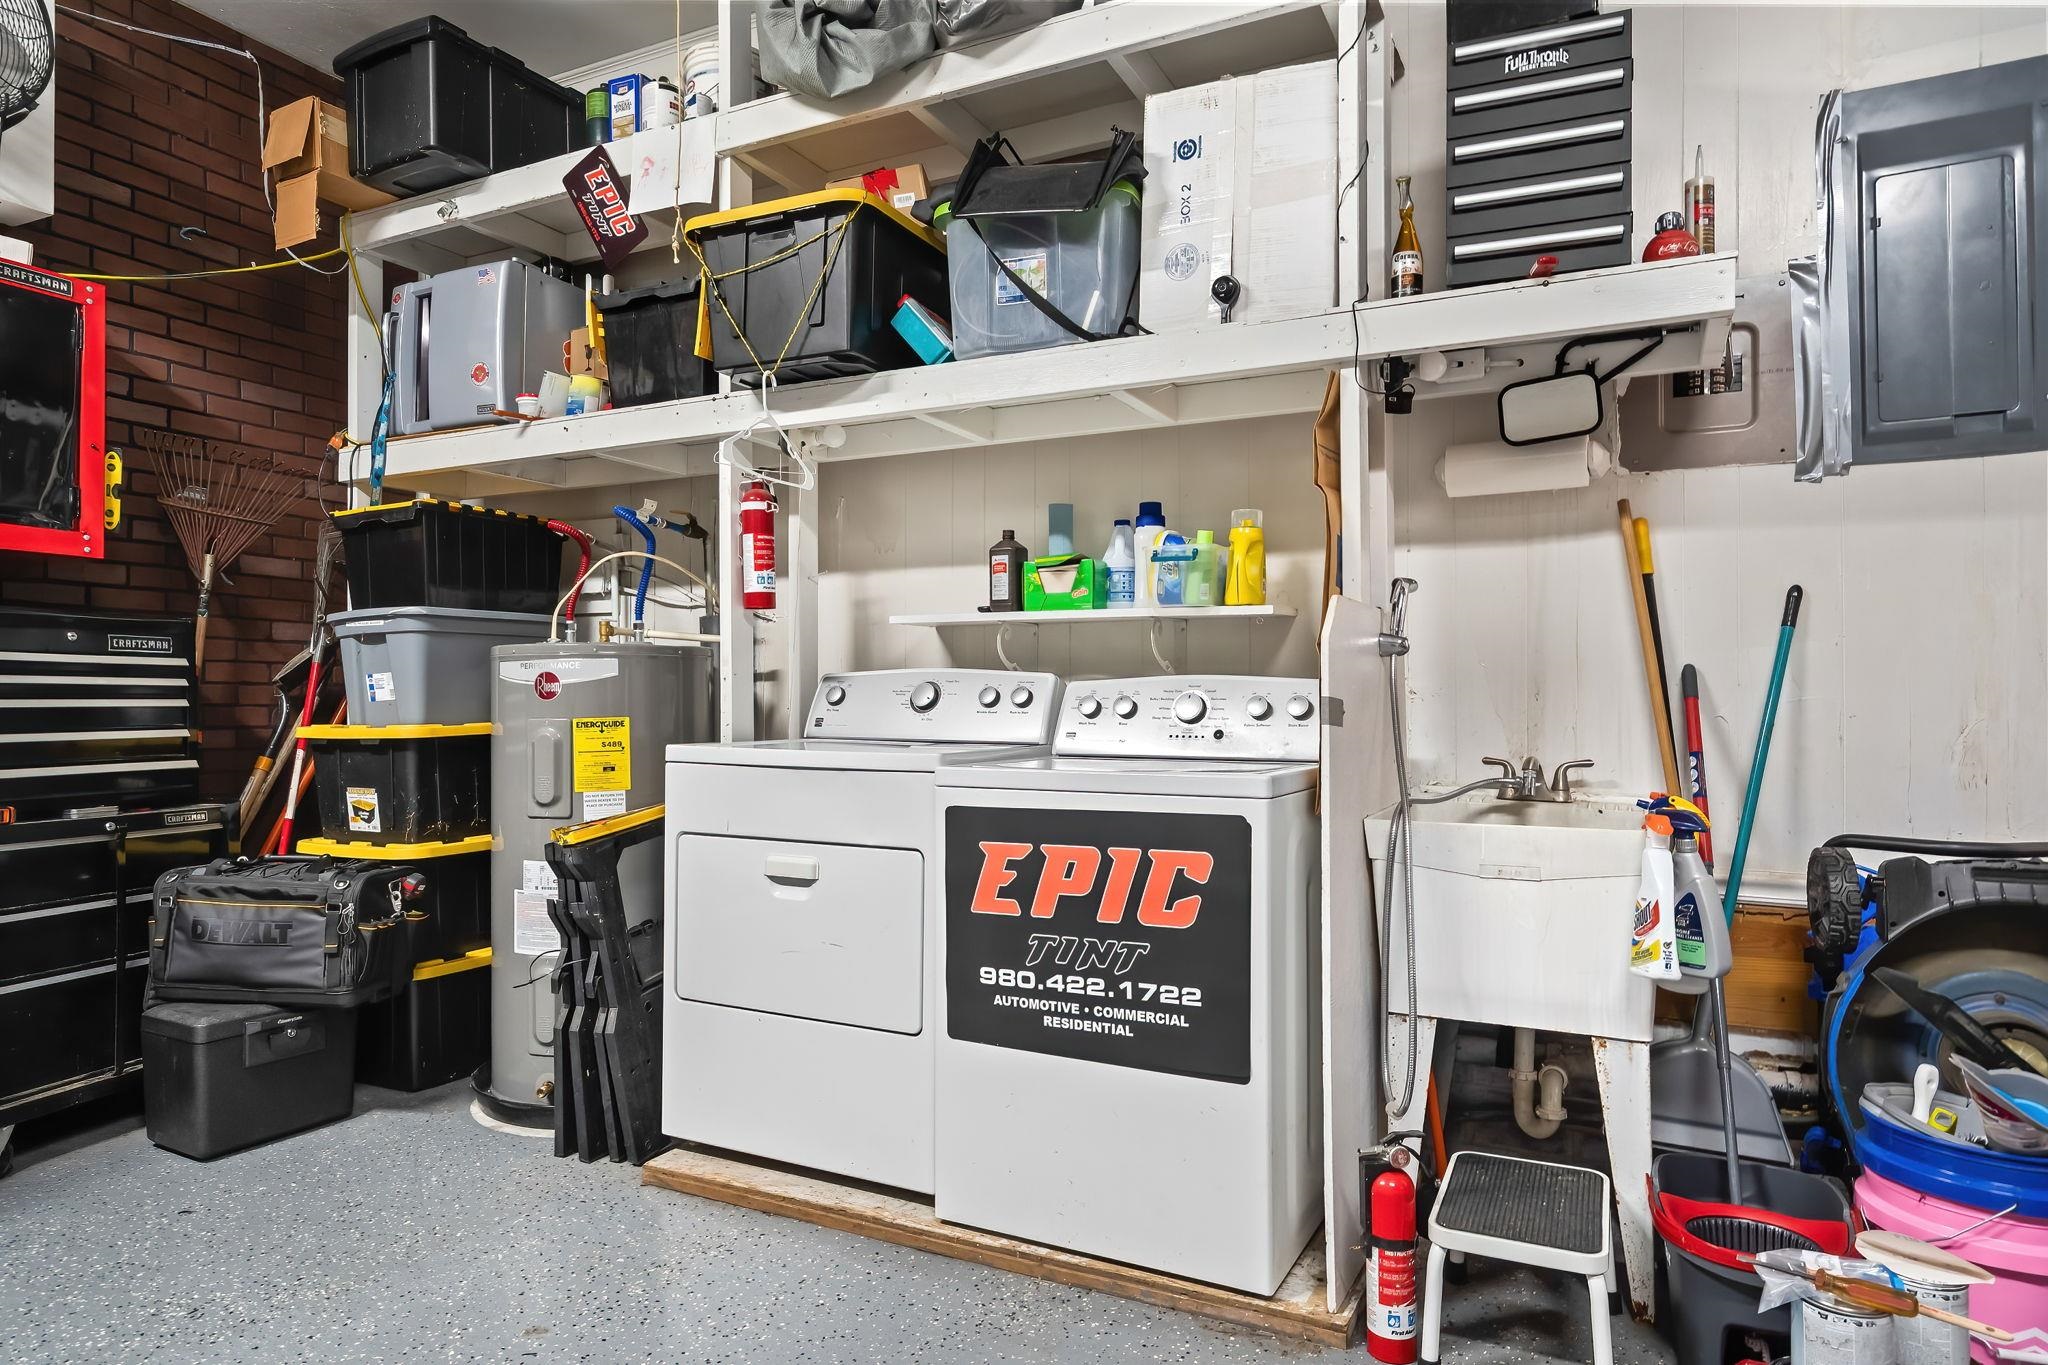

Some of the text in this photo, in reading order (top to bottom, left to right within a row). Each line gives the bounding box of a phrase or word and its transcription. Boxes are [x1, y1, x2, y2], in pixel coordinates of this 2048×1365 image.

[584, 163, 636, 236] EPIC
[1181, 183, 1192, 193] 2
[582, 193, 612, 236] TINT
[1071, 588, 1088, 599] Gain
[112, 638, 169, 650] CRAFTSMAN
[536, 671, 560, 696] Rheem
[576, 720, 625, 730] ENERGYGUIDE
[167, 813, 206, 824] CRAFTSMAN
[970, 841, 1214, 929] EPIC
[1025, 933, 1151, 975] TINT
[979, 966, 1203, 1007] 980.422.1722
[993, 994, 1190, 1028] AUTOMOTIVE COMMERCIAL
[1043, 1015, 1134, 1037] RESIDENTIAL
